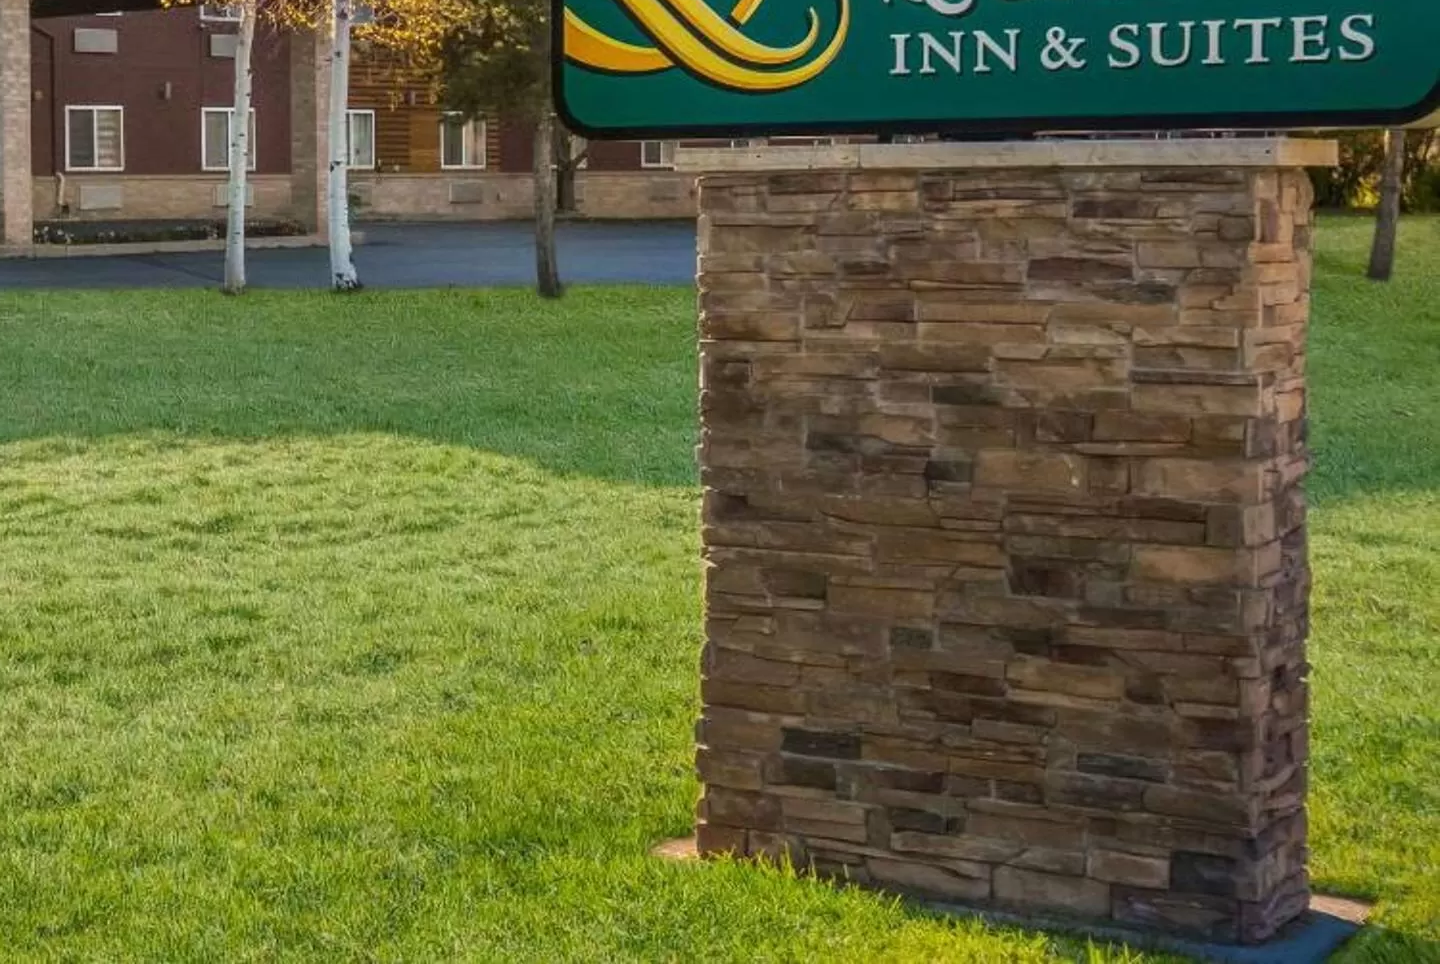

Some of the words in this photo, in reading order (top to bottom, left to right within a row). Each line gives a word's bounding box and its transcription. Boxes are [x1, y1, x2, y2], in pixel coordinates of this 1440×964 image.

[890, 29, 1021, 75] INN
[1040, 26, 1086, 70] &
[1108, 14, 1375, 67] SUITES
